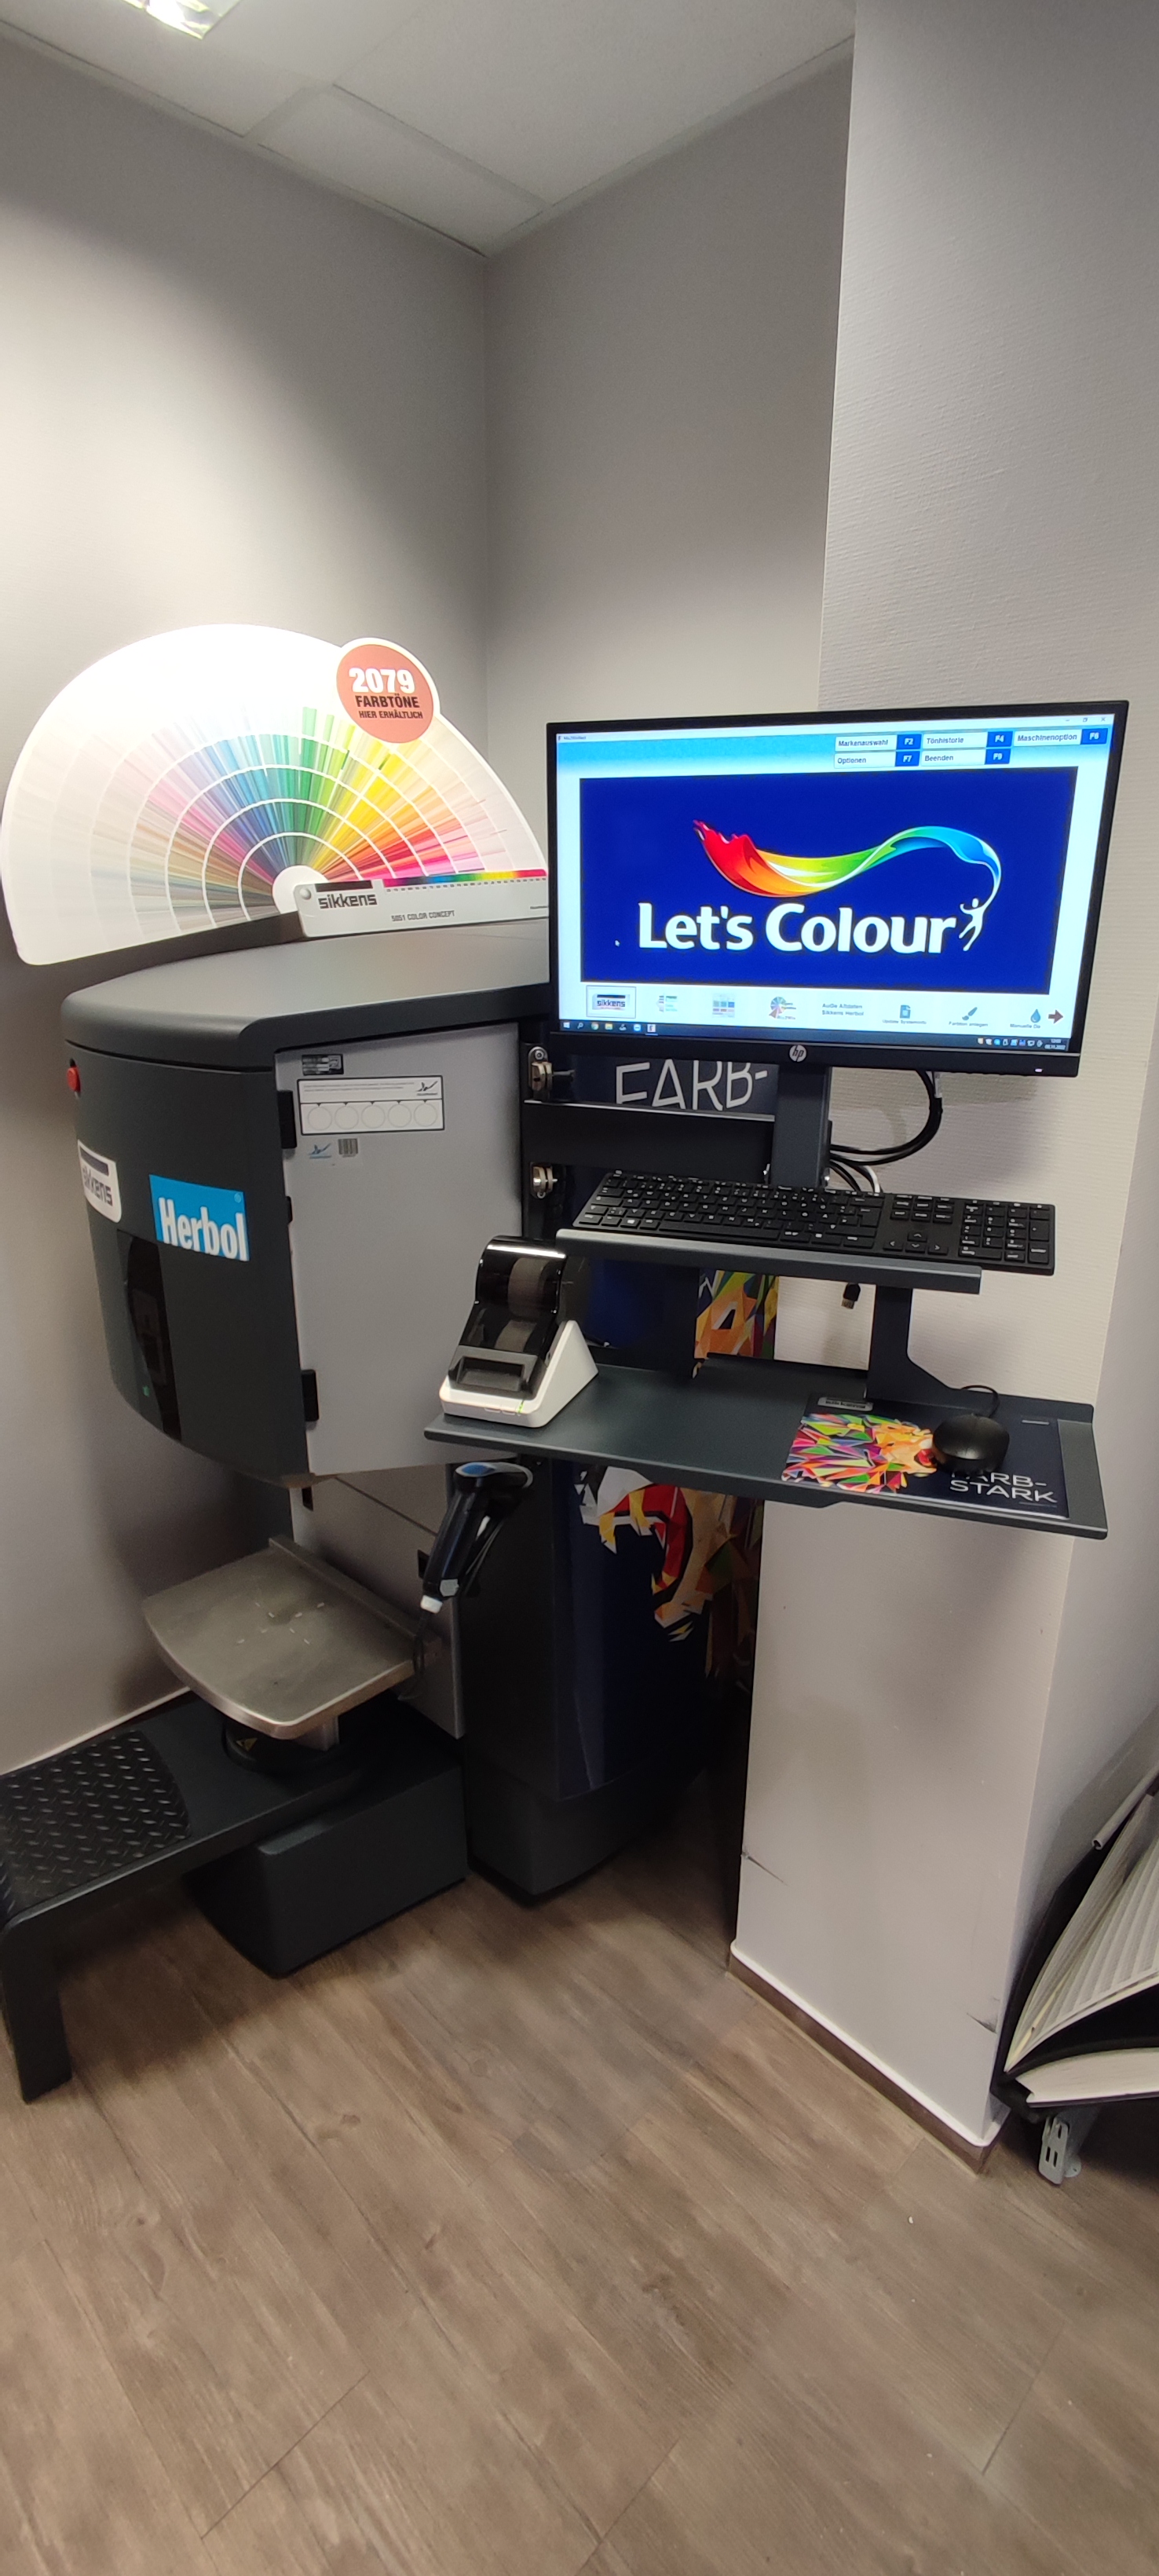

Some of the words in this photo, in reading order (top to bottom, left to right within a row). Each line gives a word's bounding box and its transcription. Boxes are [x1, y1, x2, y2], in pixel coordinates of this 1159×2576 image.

[349, 667, 416, 694] 2079
[355, 693, 420, 708] FARBTÖNE
[358, 710, 377, 719] HIER
[378, 708, 423, 719] ERHÄLTLICH
[994, 734, 1004, 743] F4
[1017, 733, 1077, 742] Maschinenoption
[317, 894, 378, 909] sikkens
[407, 913, 428, 921] COLOR
[429, 910, 455, 920] CONCEPT
[638, 902, 754, 951] Let's
[765, 902, 957, 954] Colour
[597, 999, 626, 1008] sikkens
[790, 1045, 807, 1062] hp
[616, 1059, 768, 1111] FARB-
[158, 1197, 248, 1262] Herbol
[950, 1479, 1058, 1504] STARK
